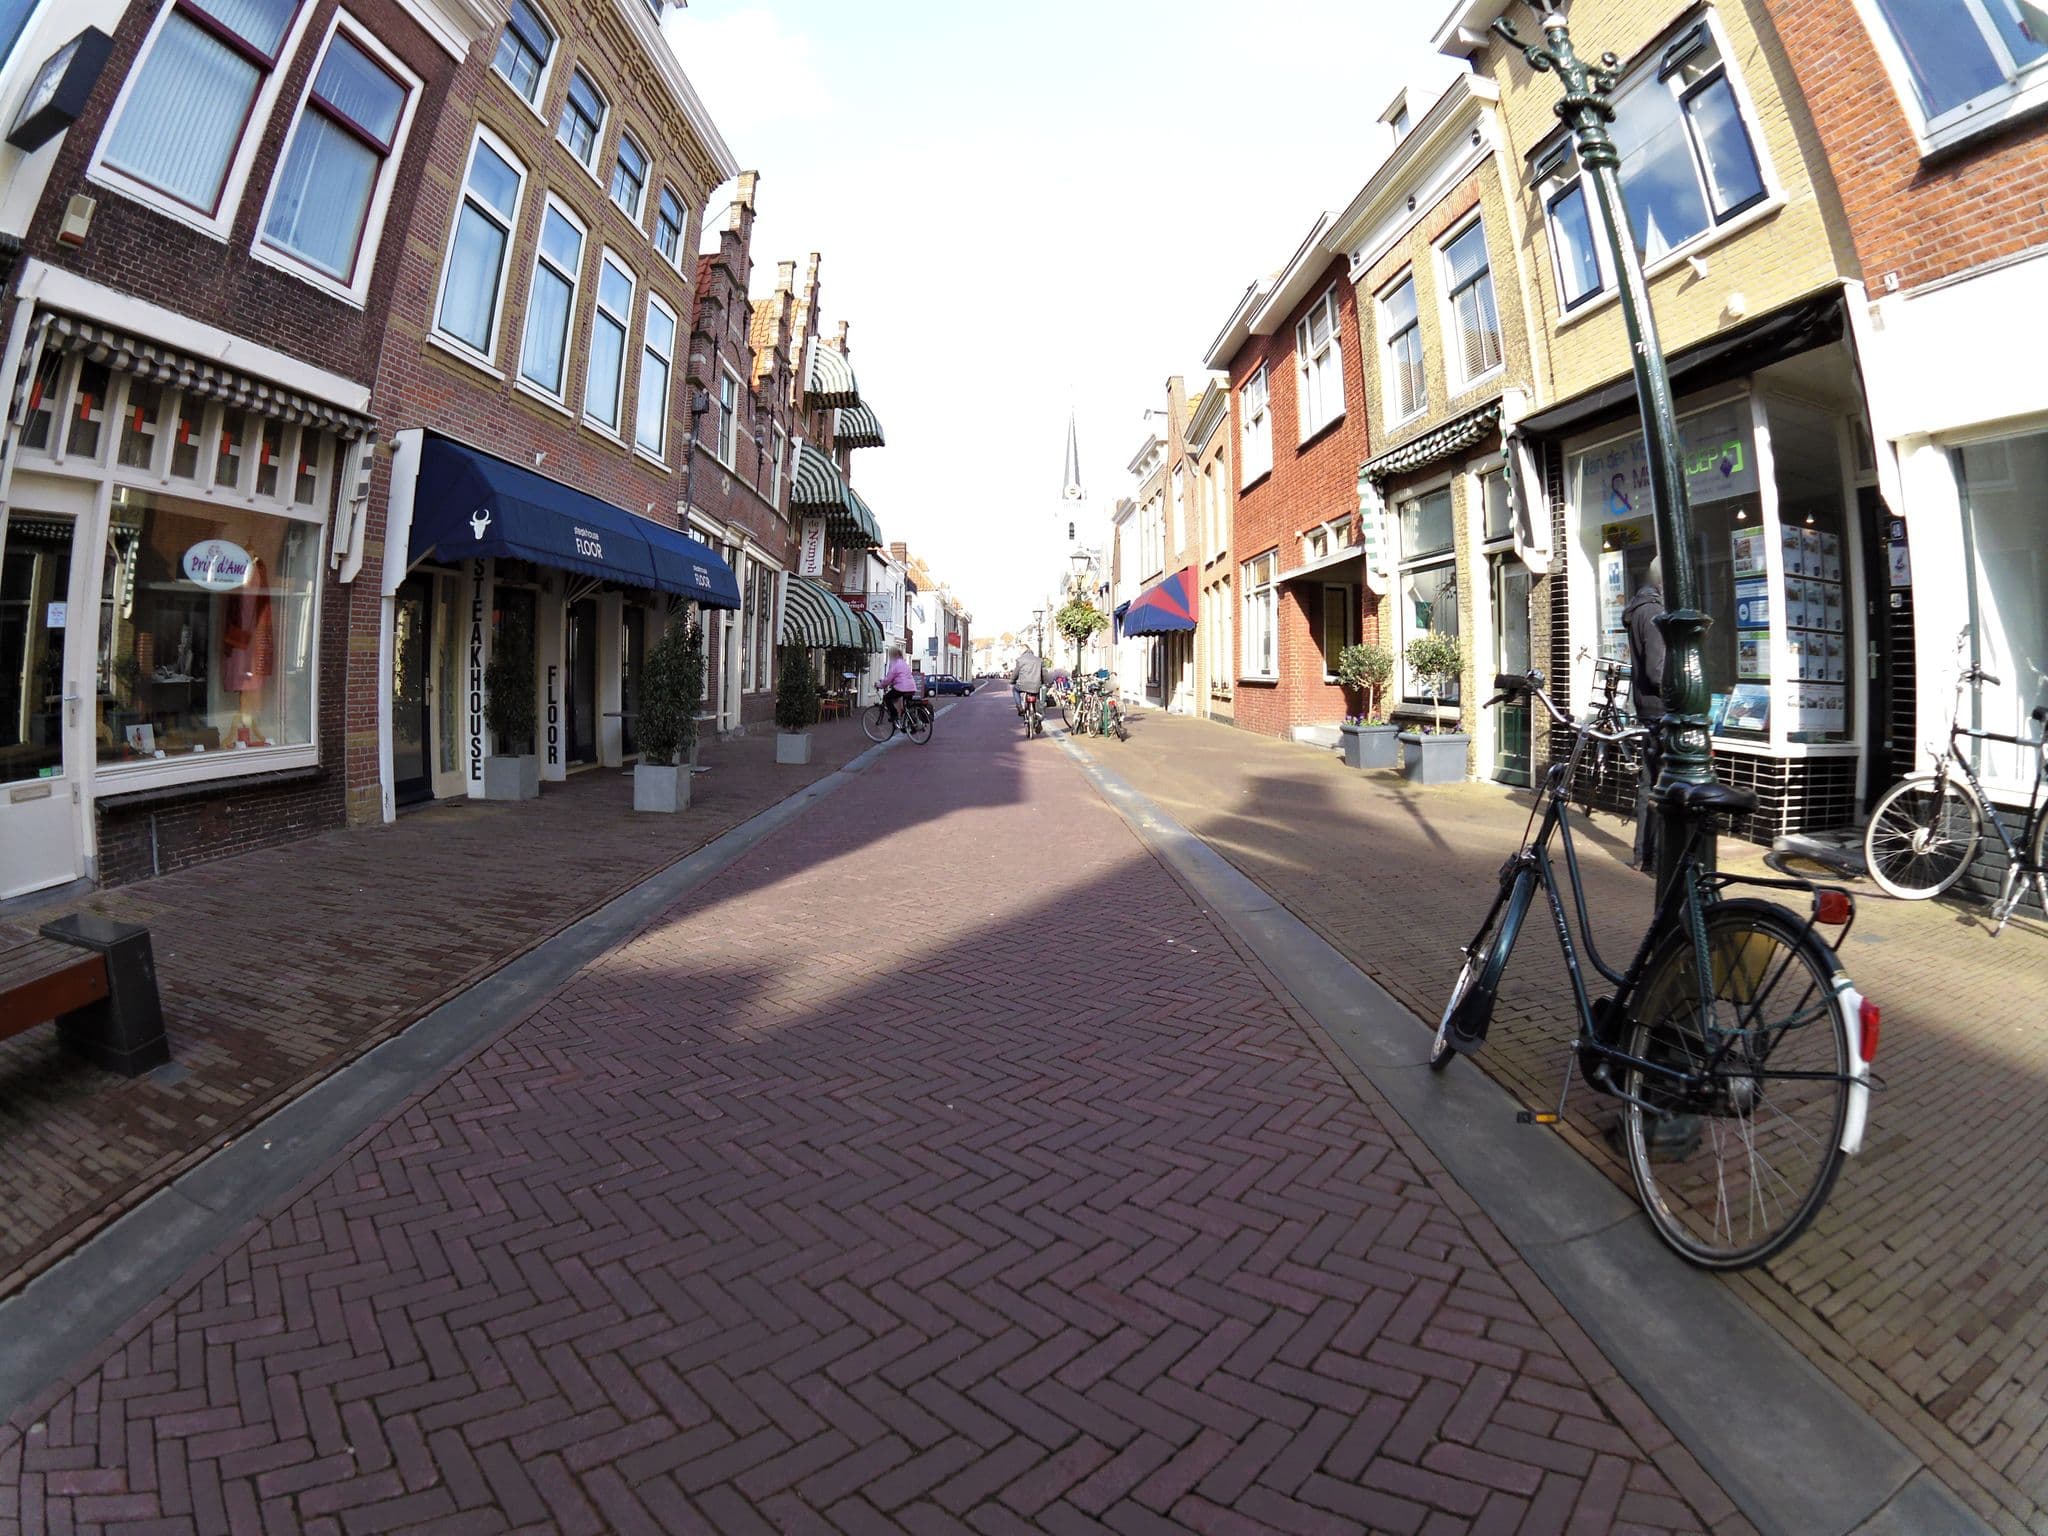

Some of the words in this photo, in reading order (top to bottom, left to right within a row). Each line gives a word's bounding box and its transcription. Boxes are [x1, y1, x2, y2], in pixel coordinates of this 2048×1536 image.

[1610, 473, 1632, 515] &
[576, 538, 603, 560] FLOOR
[806, 529, 819, 574] Nymph
[694, 573, 712, 589] FLOOR
[470, 558, 484, 780] STEAKHOUSE
[547, 665, 558, 765] FLOOR
